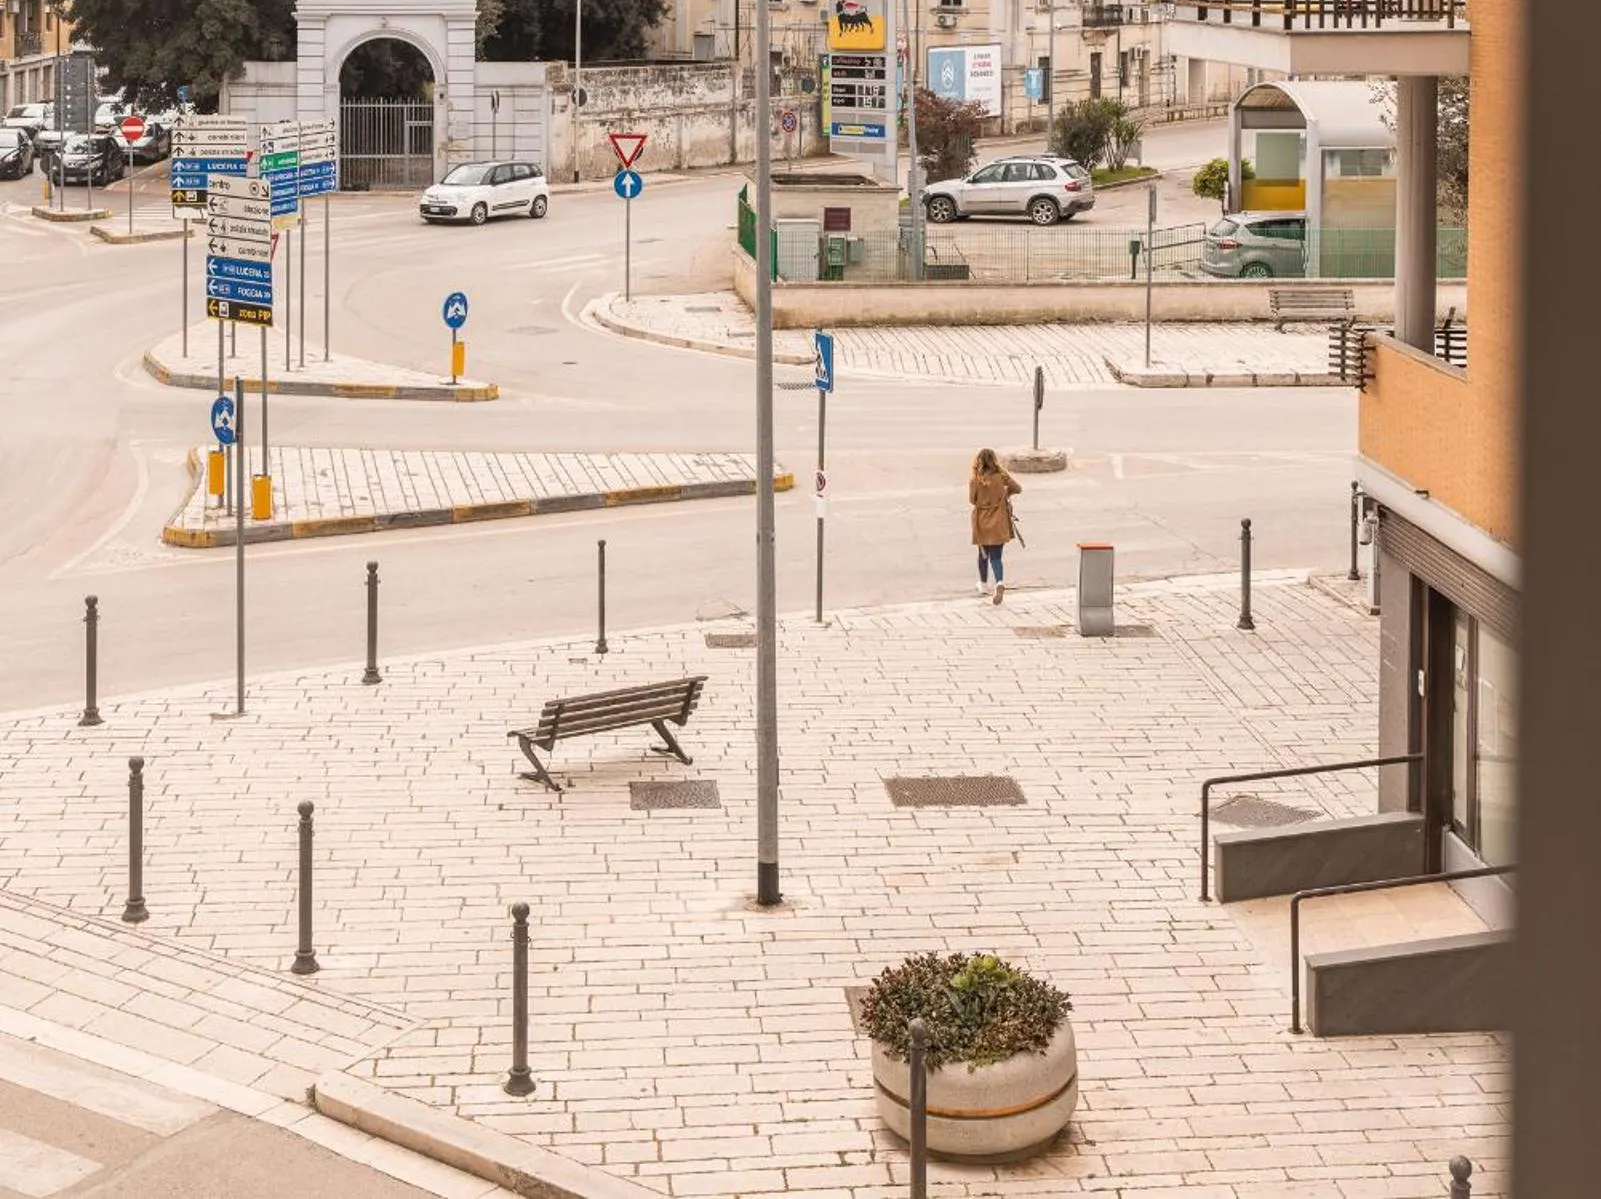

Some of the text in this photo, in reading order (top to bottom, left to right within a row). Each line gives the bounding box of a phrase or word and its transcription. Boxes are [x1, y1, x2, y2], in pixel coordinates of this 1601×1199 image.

[209, 179, 231, 190] centro
[236, 266, 263, 278] LUCERA
[237, 287, 263, 298] FOGGIA
[239, 308, 257, 319] zona
